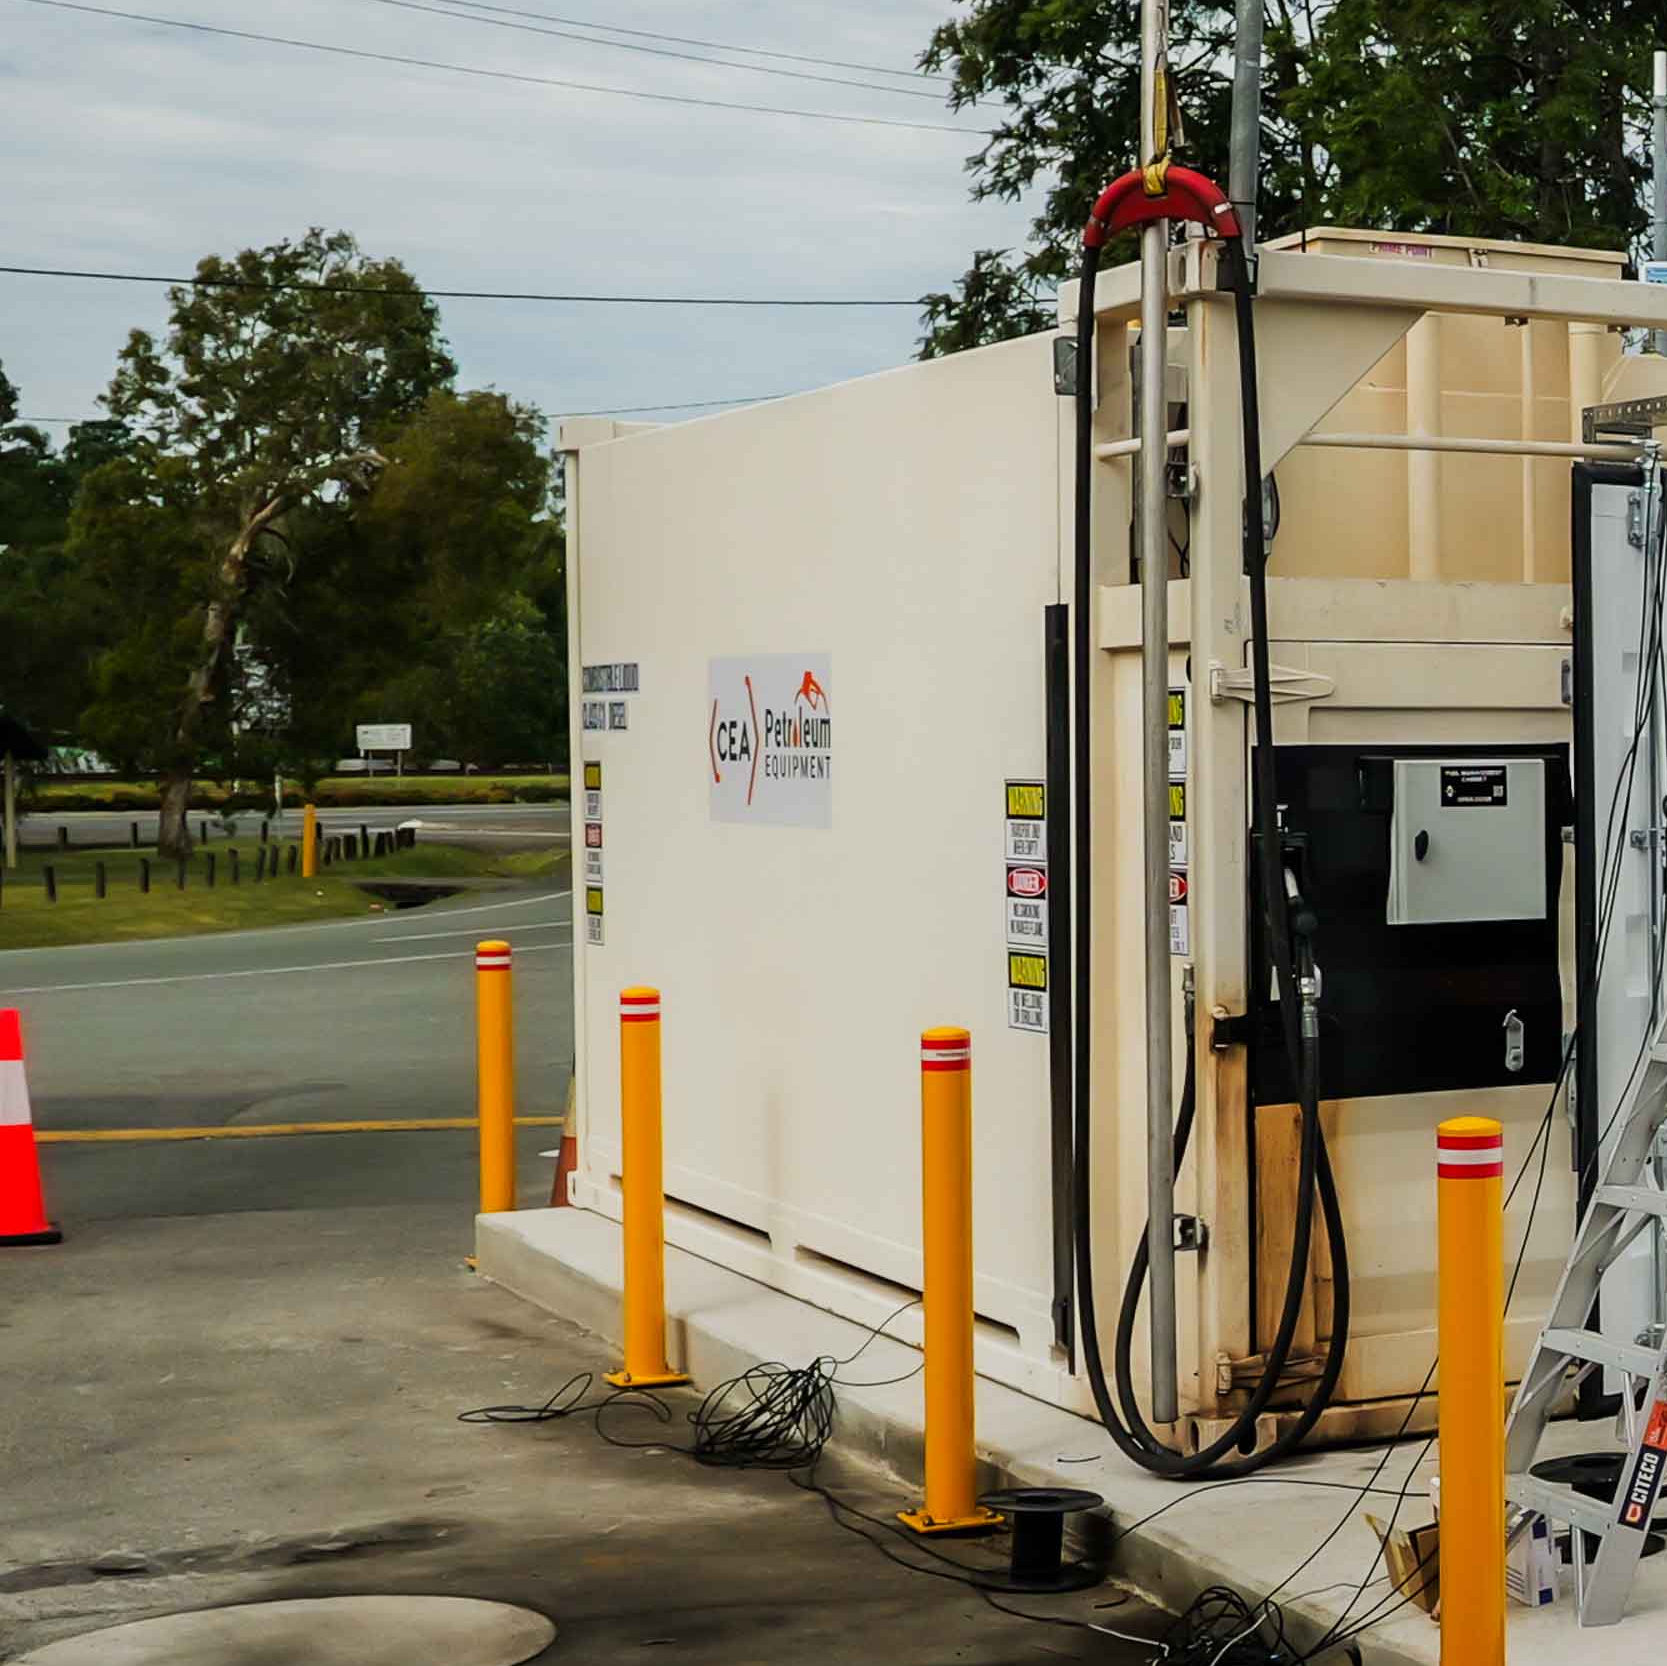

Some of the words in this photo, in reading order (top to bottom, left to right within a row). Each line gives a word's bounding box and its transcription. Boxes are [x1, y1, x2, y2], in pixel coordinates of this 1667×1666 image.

[765, 705, 832, 749] Petroleum
[765, 754, 832, 780] EQUIPMENT
[1631, 1452, 1660, 1504] CITECO
